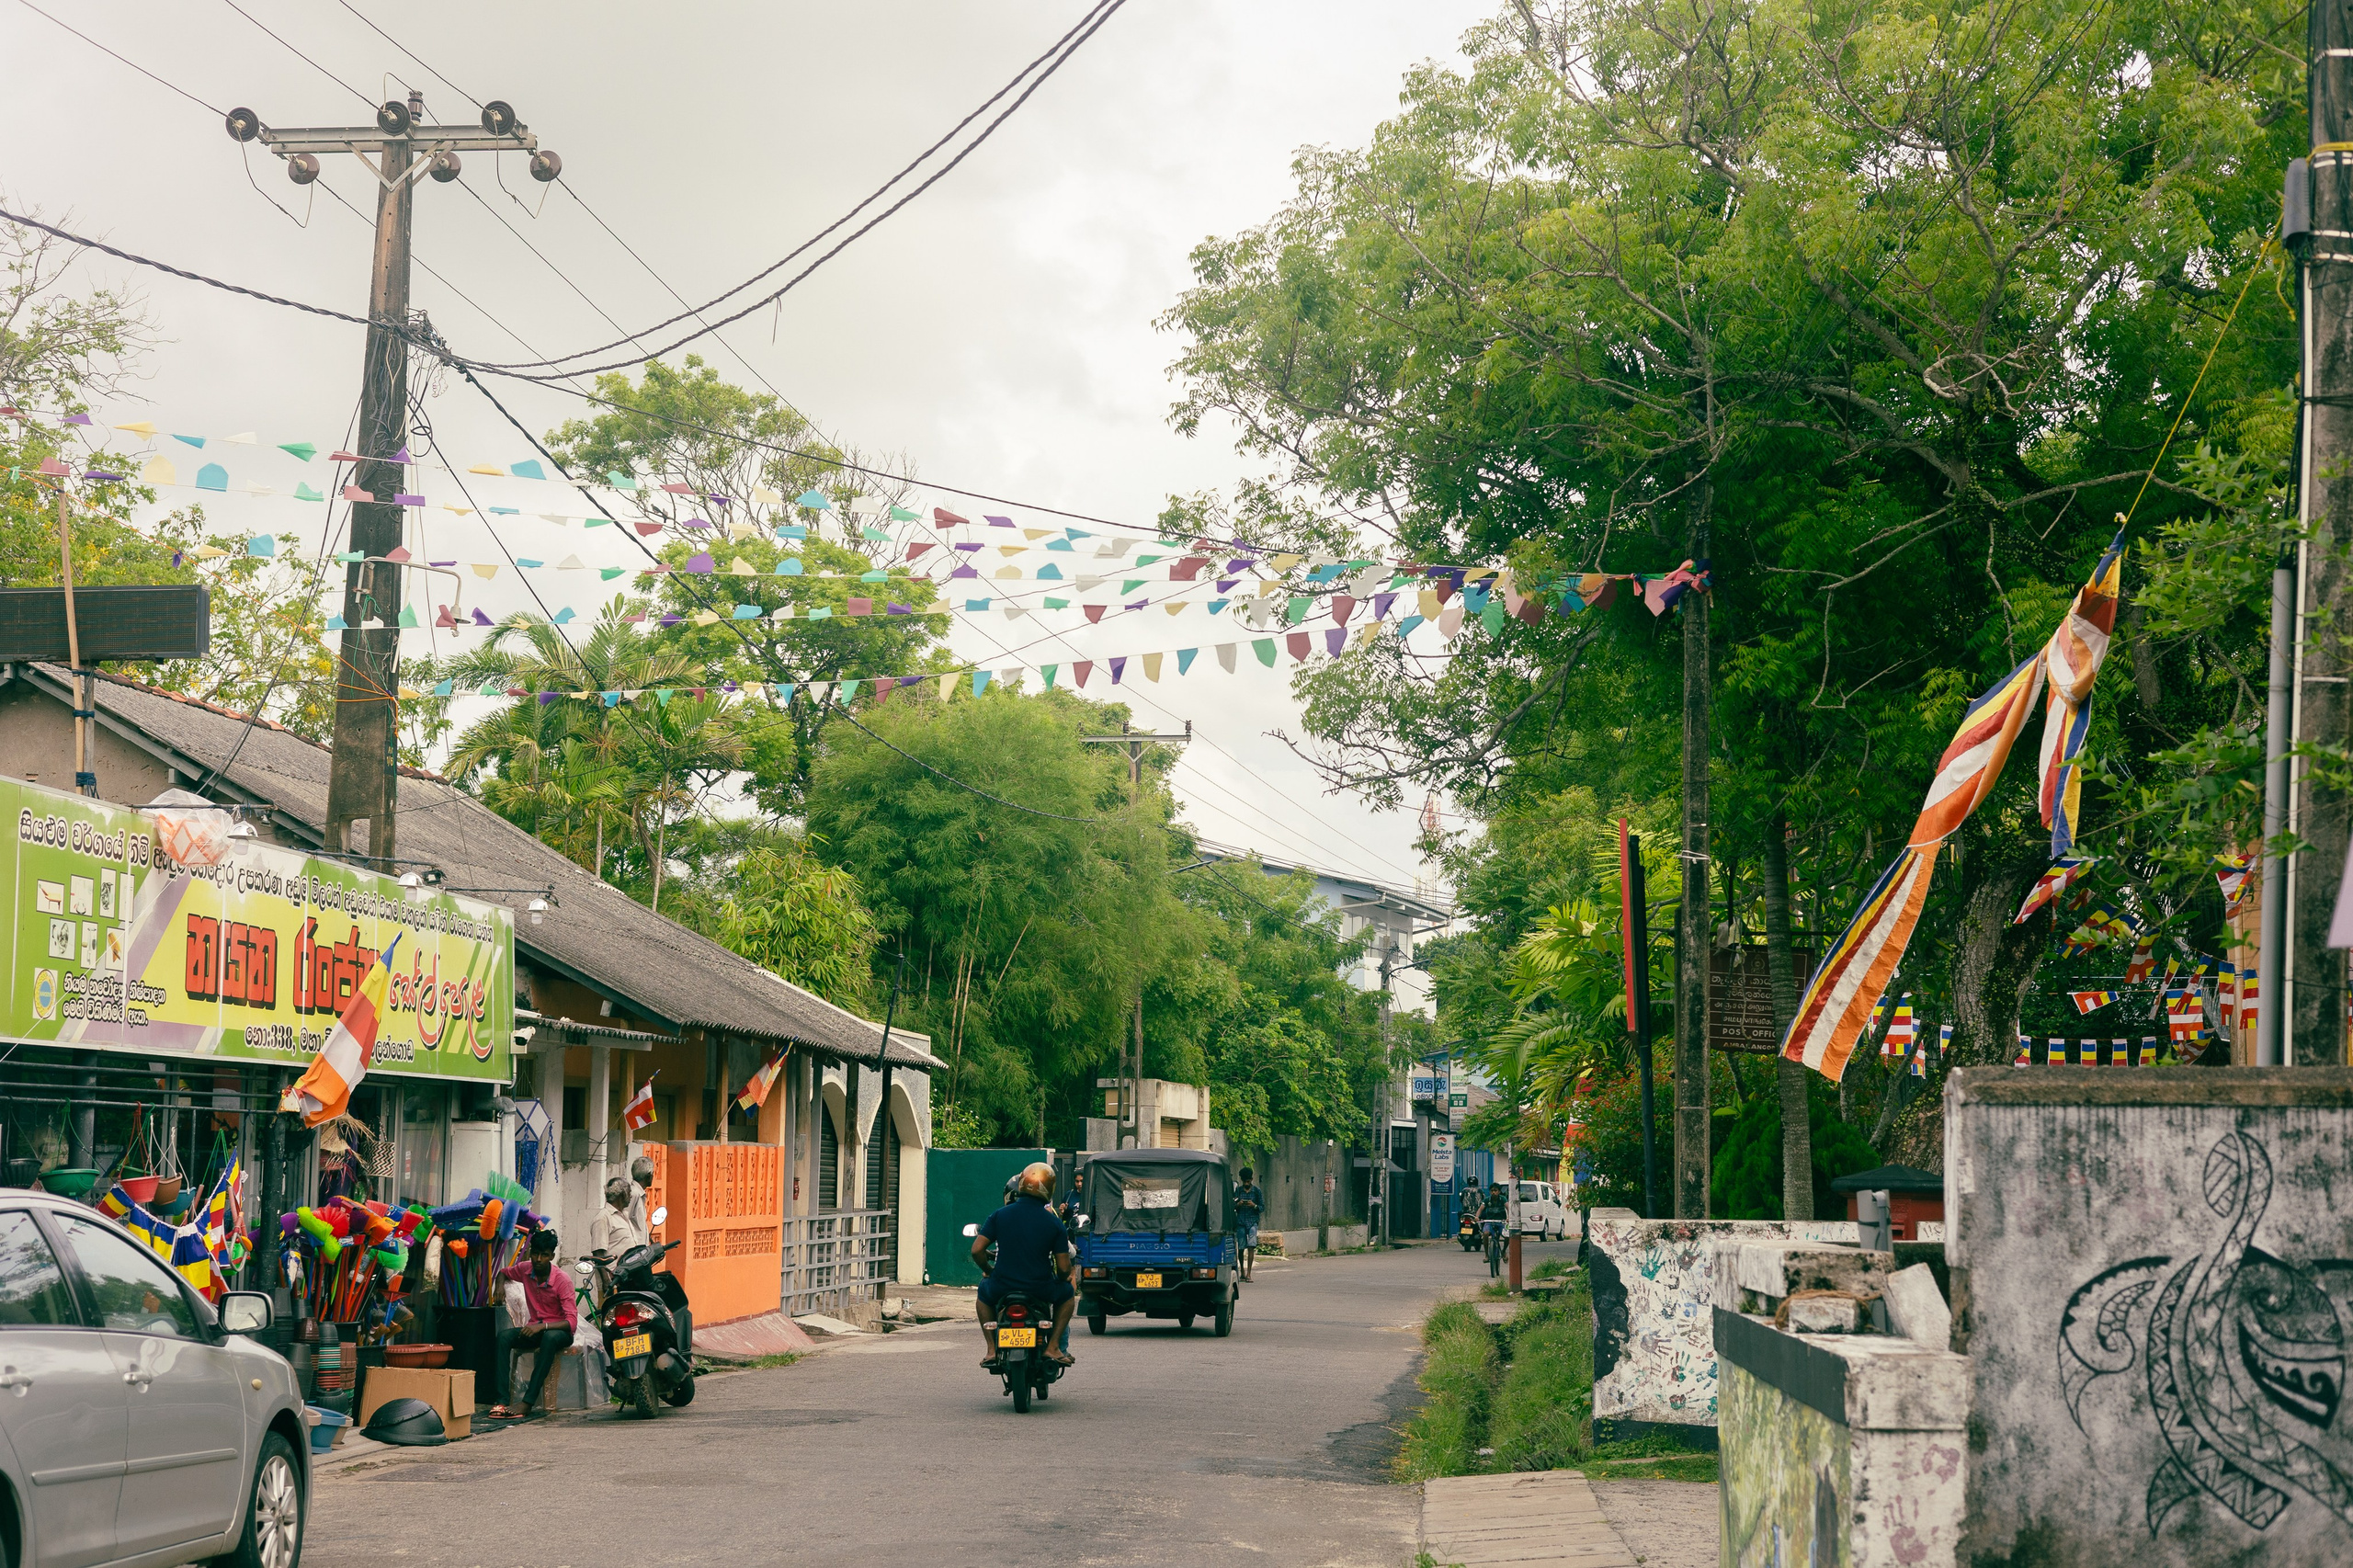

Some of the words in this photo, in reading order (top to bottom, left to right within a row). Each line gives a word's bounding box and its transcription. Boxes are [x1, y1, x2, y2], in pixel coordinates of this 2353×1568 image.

[72, 823, 125, 860] වර්ගයේ
[237, 868, 282, 896] උපකරණ
[285, 875, 308, 907] අඩුම
[311, 877, 342, 912] මිලටත්
[344, 888, 378, 919] අඩුවෙන්
[379, 895, 399, 922] එකම
[185, 913, 278, 1011] නයන
[63, 971, 87, 994] නියම
[63, 998, 85, 1019] මෙහි
[300, 1027, 322, 1053] මහා
[1752, 1029, 1776, 1038] OFFIC
[625, 1344, 645, 1356] 7183
[626, 1335, 644, 1346] BFH
[1010, 1338, 1030, 1346] 4559
